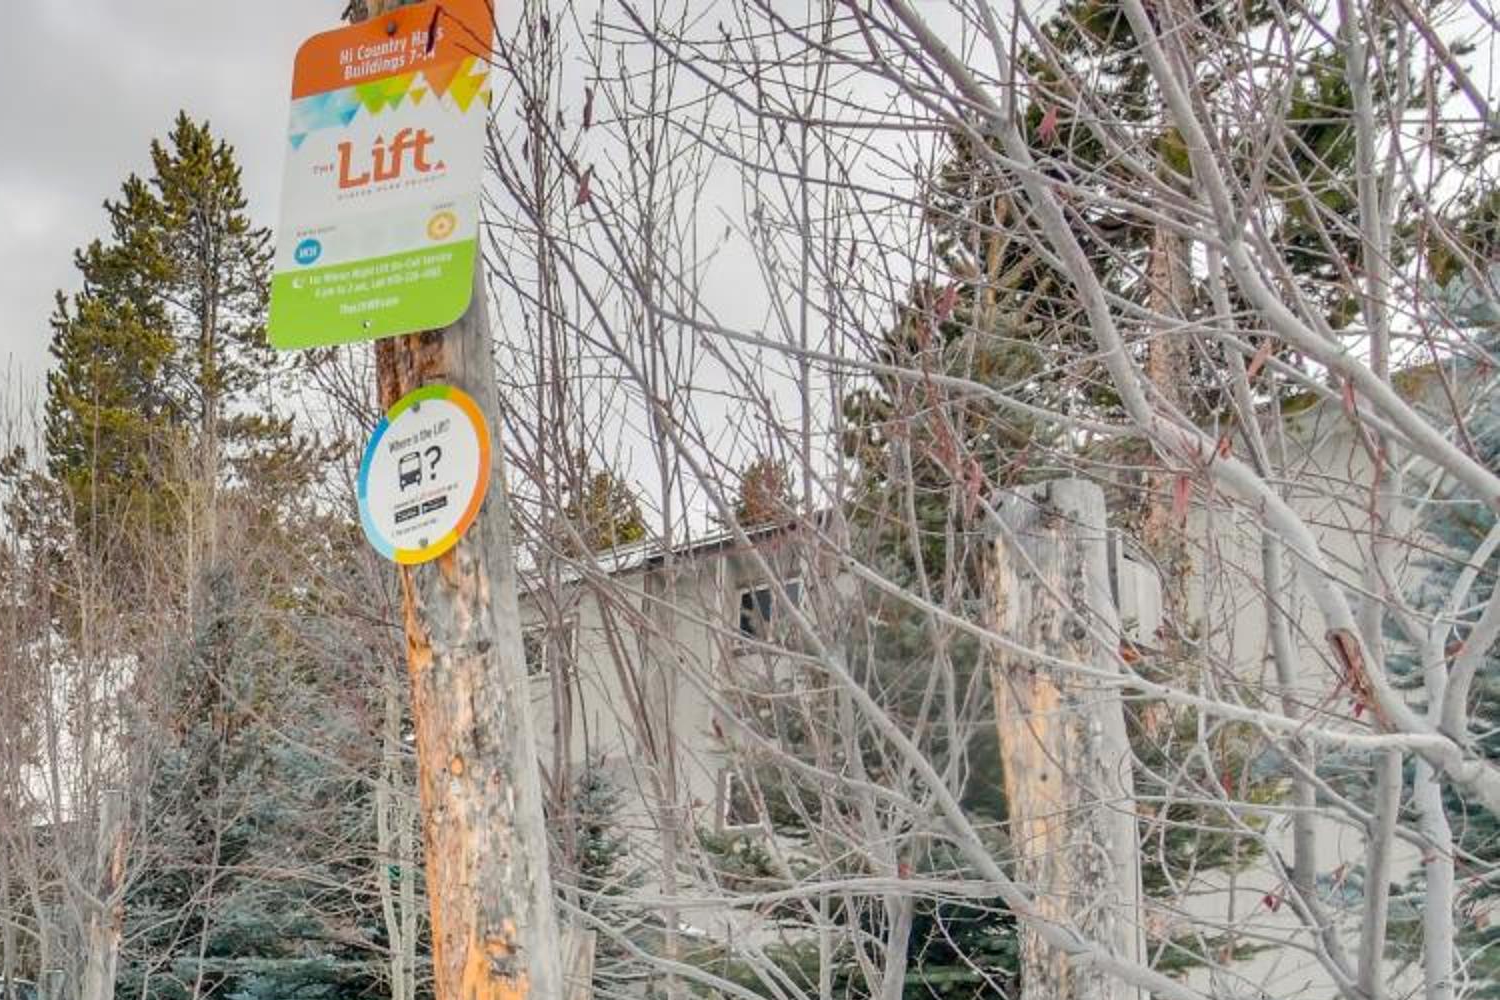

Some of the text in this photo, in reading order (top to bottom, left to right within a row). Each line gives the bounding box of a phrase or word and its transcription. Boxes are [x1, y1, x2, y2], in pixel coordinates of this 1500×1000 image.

[340, 28, 444, 65] Hi Country Has
[344, 54, 405, 80] Buildings
[425, 445, 442, 480] ?
